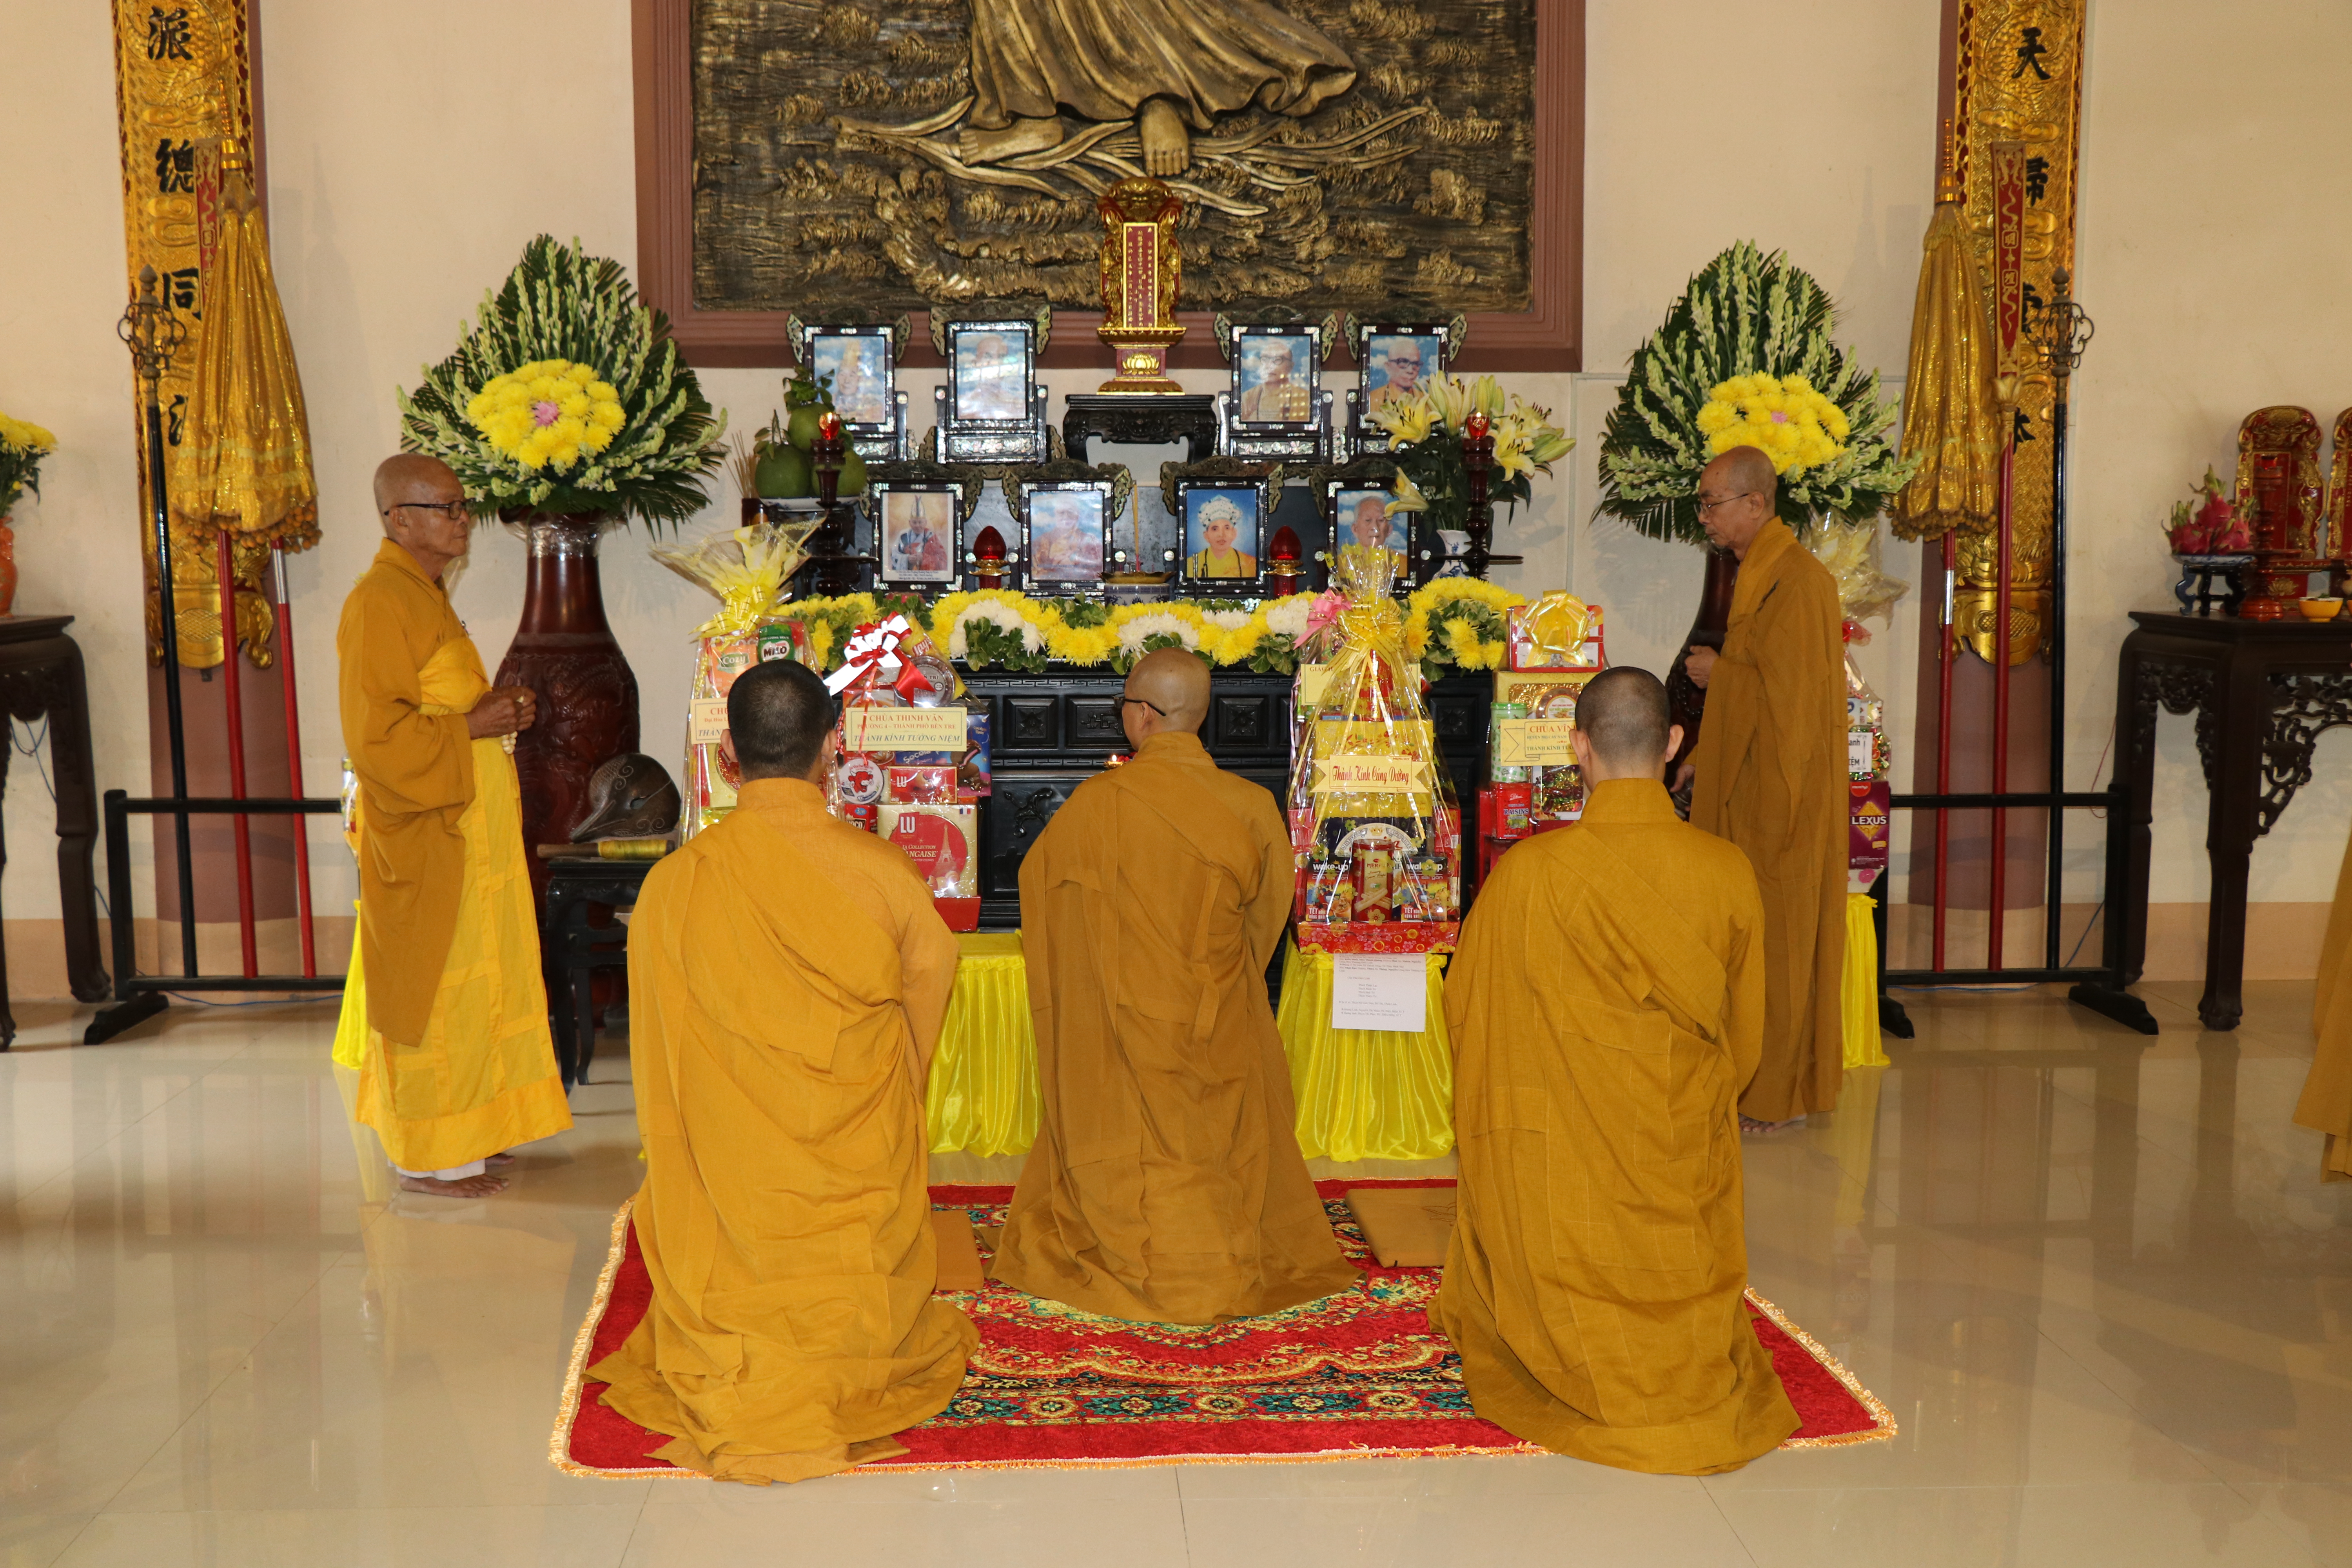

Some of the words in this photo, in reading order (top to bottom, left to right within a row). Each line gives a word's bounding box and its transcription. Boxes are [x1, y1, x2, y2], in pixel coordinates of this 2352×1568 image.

[764, 646, 787, 657] MILO
[723, 655, 746, 665] Cozy
[869, 713, 893, 722] CHÙA
[699, 727, 724, 737] THÀN
[1530, 724, 1554, 733] CHÙA
[884, 733, 905, 742] KÍNH
[907, 733, 936, 742] TƯỞNG
[938, 735, 960, 743] NIỆM
[1333, 766, 1352, 781] Thành
[1354, 766, 1370, 781] Kính
[1372, 766, 1387, 785] Cúng
[1389, 766, 1409, 785] Dường
[897, 776, 907, 787] LU
[900, 816, 916, 833] LU
[1852, 816, 1887, 826] LEXUS
